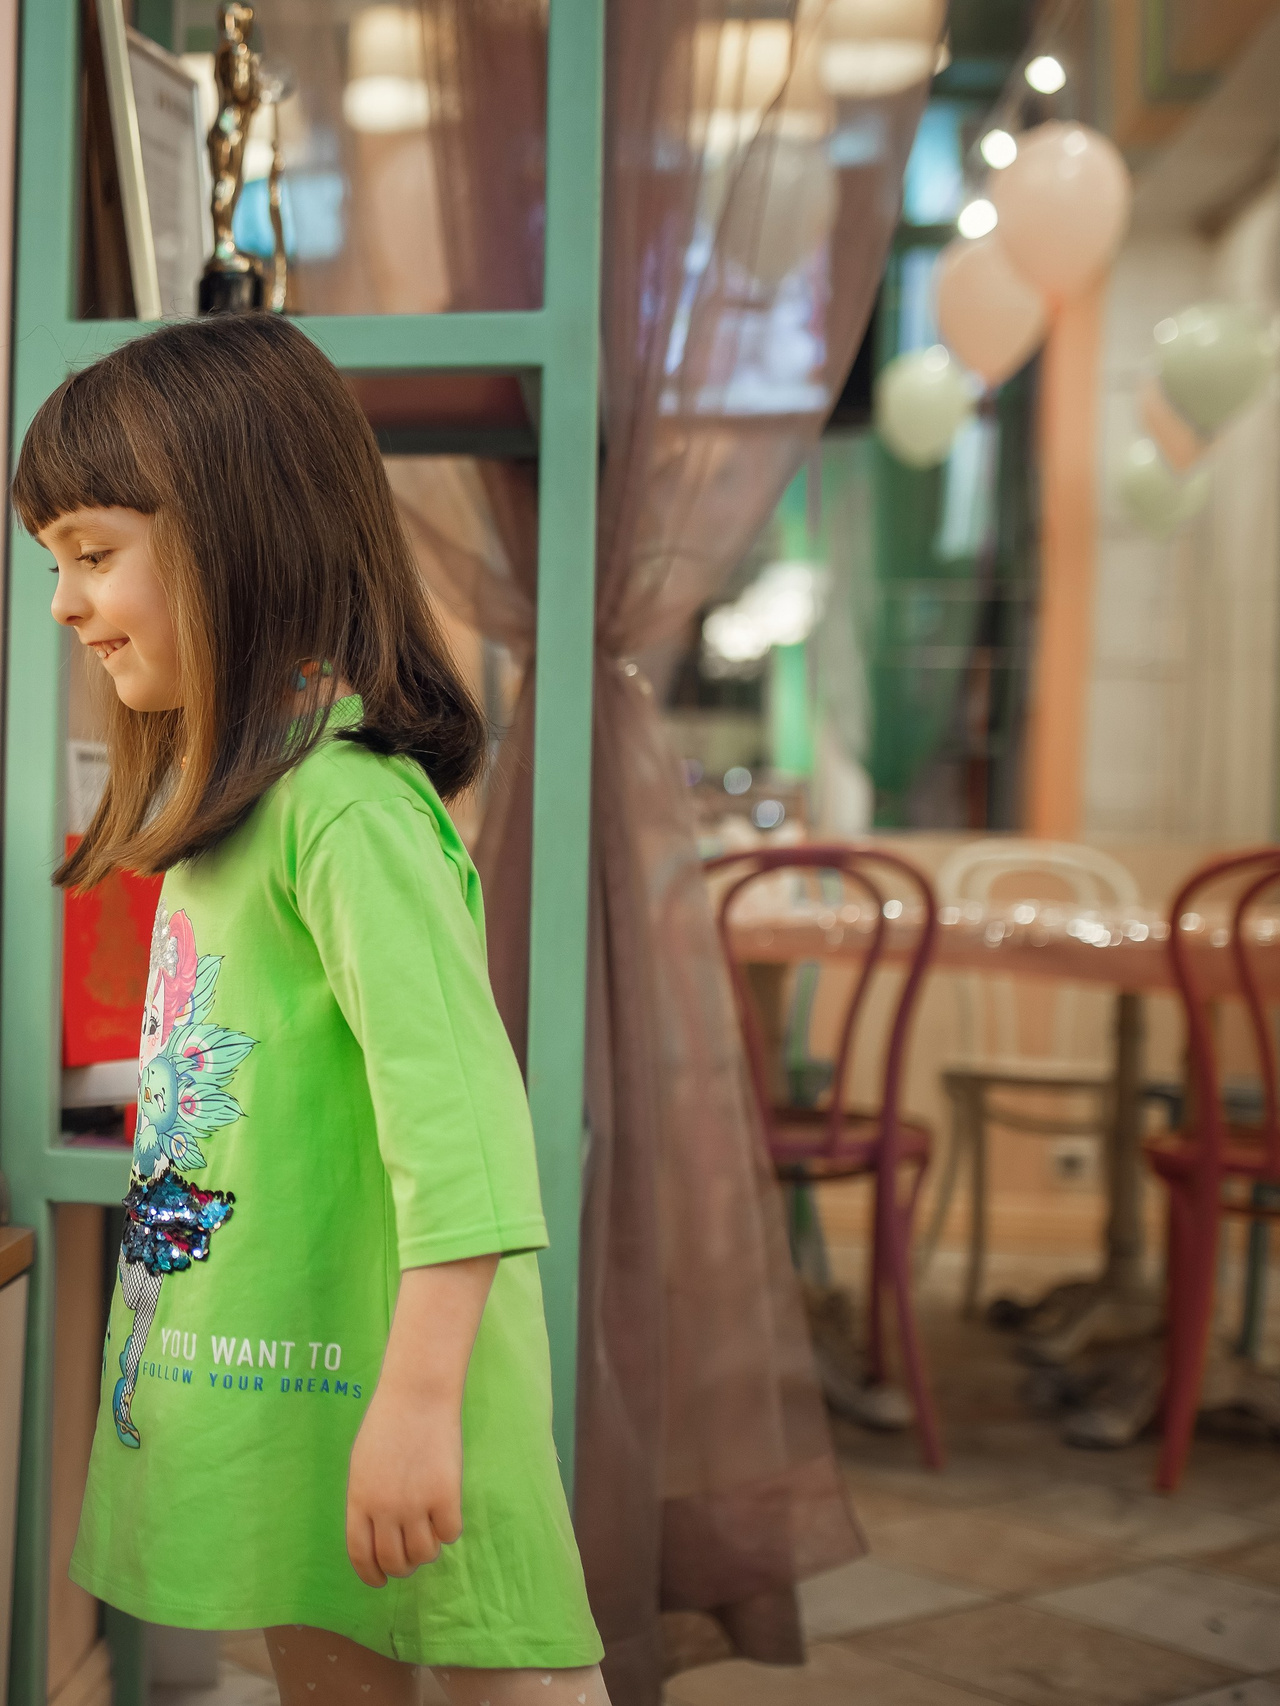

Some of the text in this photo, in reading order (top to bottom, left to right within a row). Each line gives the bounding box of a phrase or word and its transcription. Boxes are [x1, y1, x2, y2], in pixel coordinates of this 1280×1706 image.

[160, 1327, 342, 1371] YOU WANT TO
[142, 1361, 363, 1399] FOLLOW YOUR DREAMS
